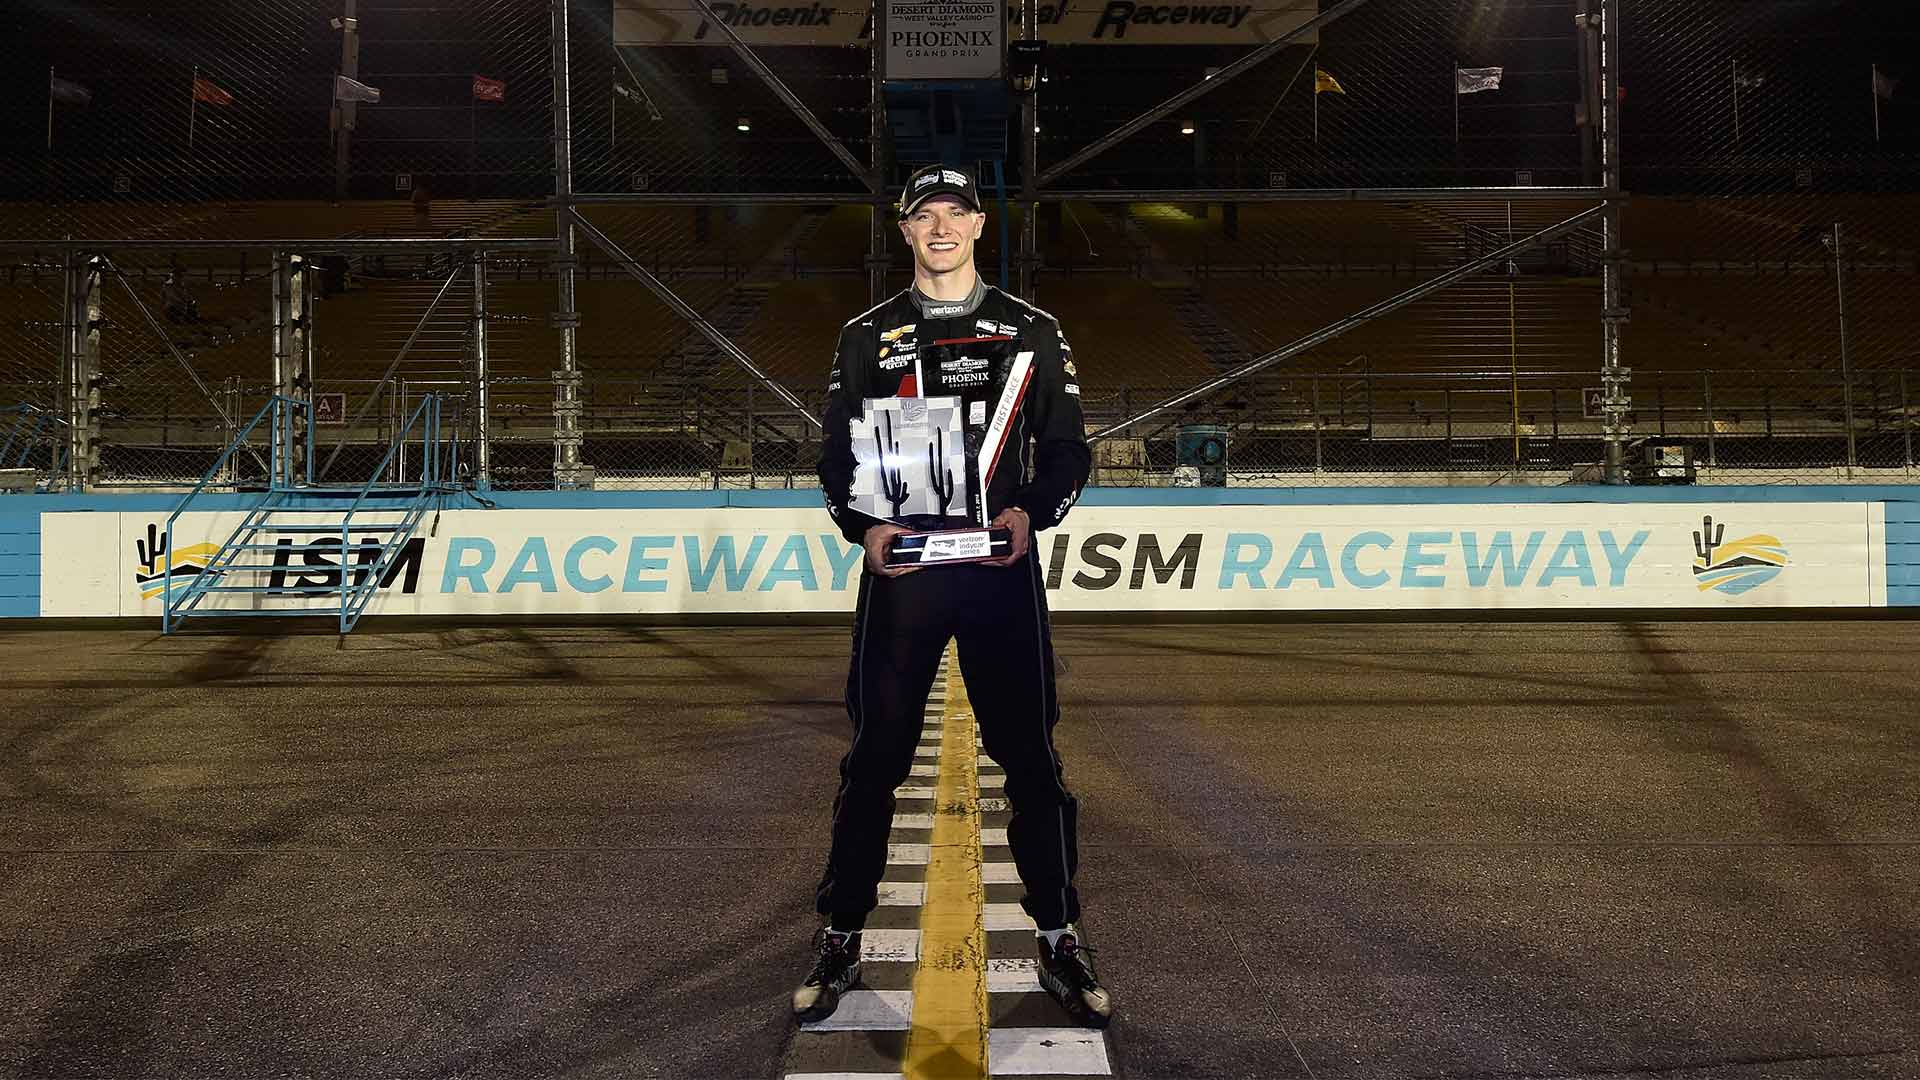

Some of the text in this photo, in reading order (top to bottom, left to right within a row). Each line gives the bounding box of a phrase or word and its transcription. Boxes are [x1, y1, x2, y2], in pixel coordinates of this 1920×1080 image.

[891, 5, 995, 14] DESERT DIAMOND
[694, 2, 836, 40] Phoenix
[1092, 1, 1250, 38] Raceway
[891, 31, 993, 46] PHOENIX
[906, 49, 980, 57] GRAND PRIX
[930, 305, 963, 315] verizon
[942, 372, 989, 383] PHOENIX
[317, 398, 331, 413] A
[993, 376, 1020, 432] FIRST PLACE
[958, 535, 984, 543] verizon
[959, 542, 984, 550] indycar
[267, 534, 863, 595] ISM RACEWAY
[1046, 530, 1651, 591] ISM RACEWAY
